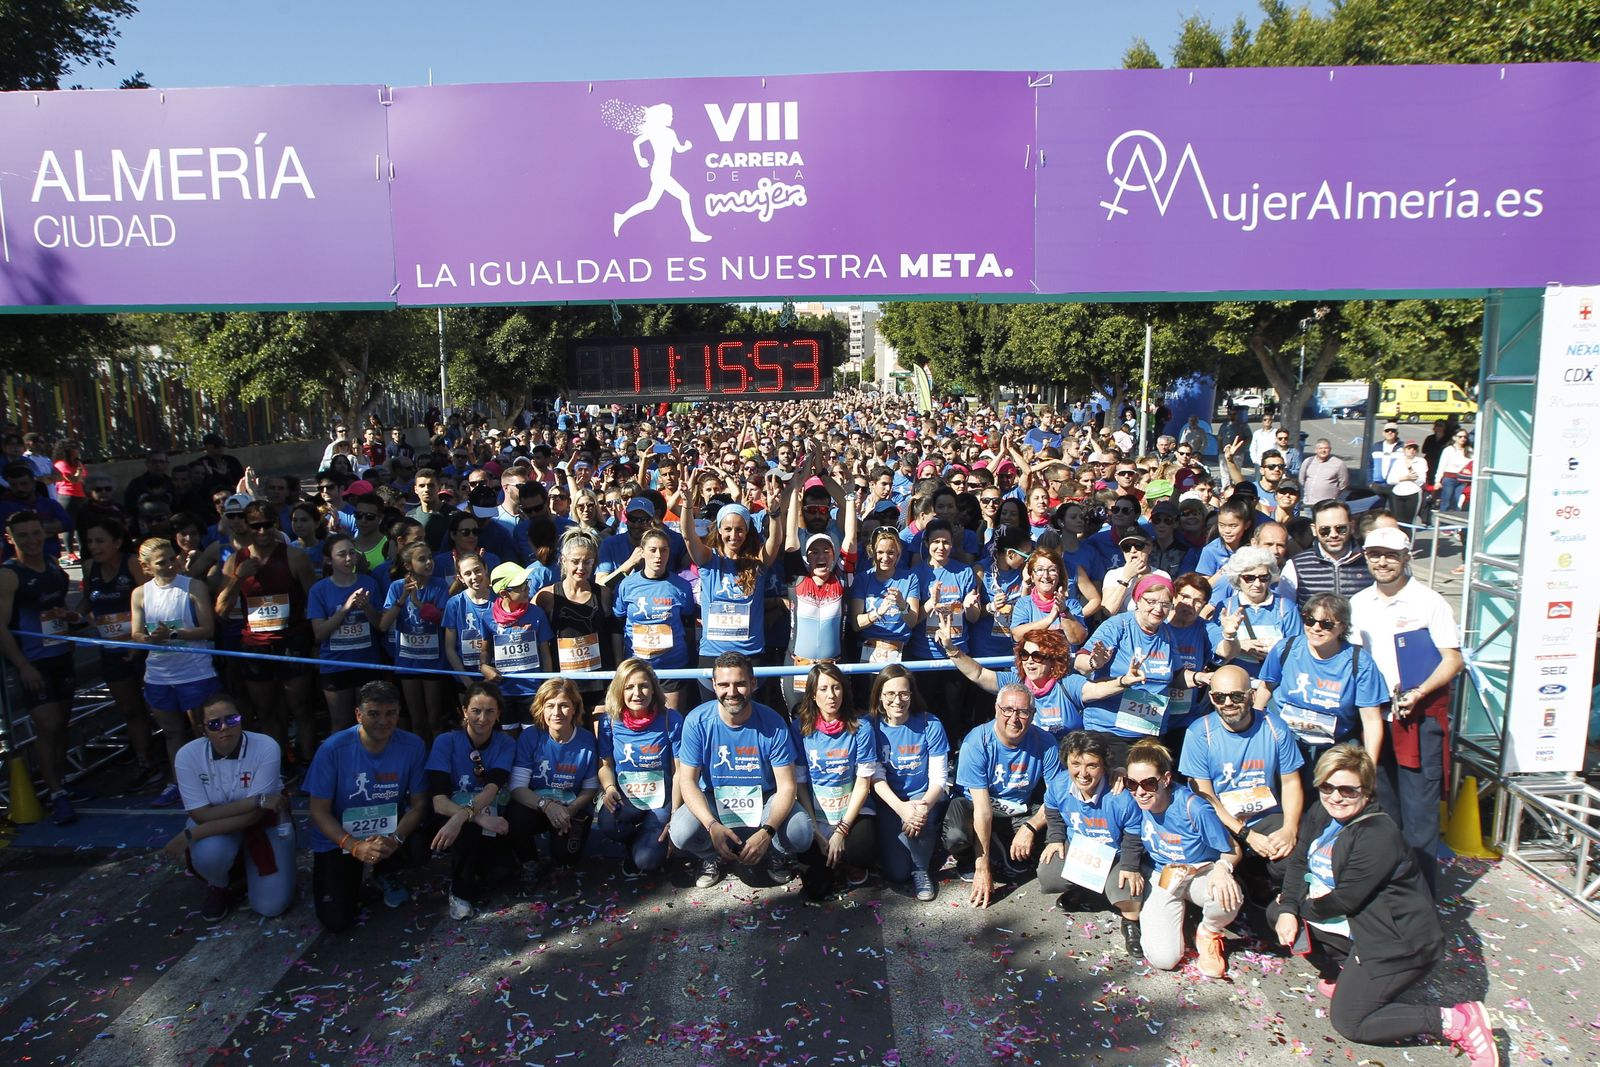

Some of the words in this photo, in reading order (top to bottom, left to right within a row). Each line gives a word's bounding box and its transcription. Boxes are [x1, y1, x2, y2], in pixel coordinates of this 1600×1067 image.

[703, 101, 799, 142] VIII
[31, 132, 316, 203] ALMERÍA
[705, 150, 805, 169] CARRERA
[706, 171, 740, 182] DE
[772, 169, 804, 181] LA
[705, 177, 808, 223] mujer
[33, 214, 176, 248] CIUDAD
[415, 263, 457, 288] LA
[469, 258, 652, 287] IGUALDAD
[666, 256, 708, 283] ES
[721, 253, 888, 281] NUESTRA
[899, 253, 1015, 279] META.
[1563, 365, 1597, 383] CDX
[1556, 505, 1581, 520] ego
[257, 605, 279, 616] 419
[715, 615, 742, 625] 1214
[104, 623, 123, 634] 382
[502, 643, 531, 656] 1038
[569, 646, 591, 658] 102
[1127, 700, 1159, 717] 2118
[625, 782, 657, 794] 2273
[722, 798, 755, 811] 2260
[352, 816, 389, 832] 2278
[1069, 847, 1103, 868] 2283
